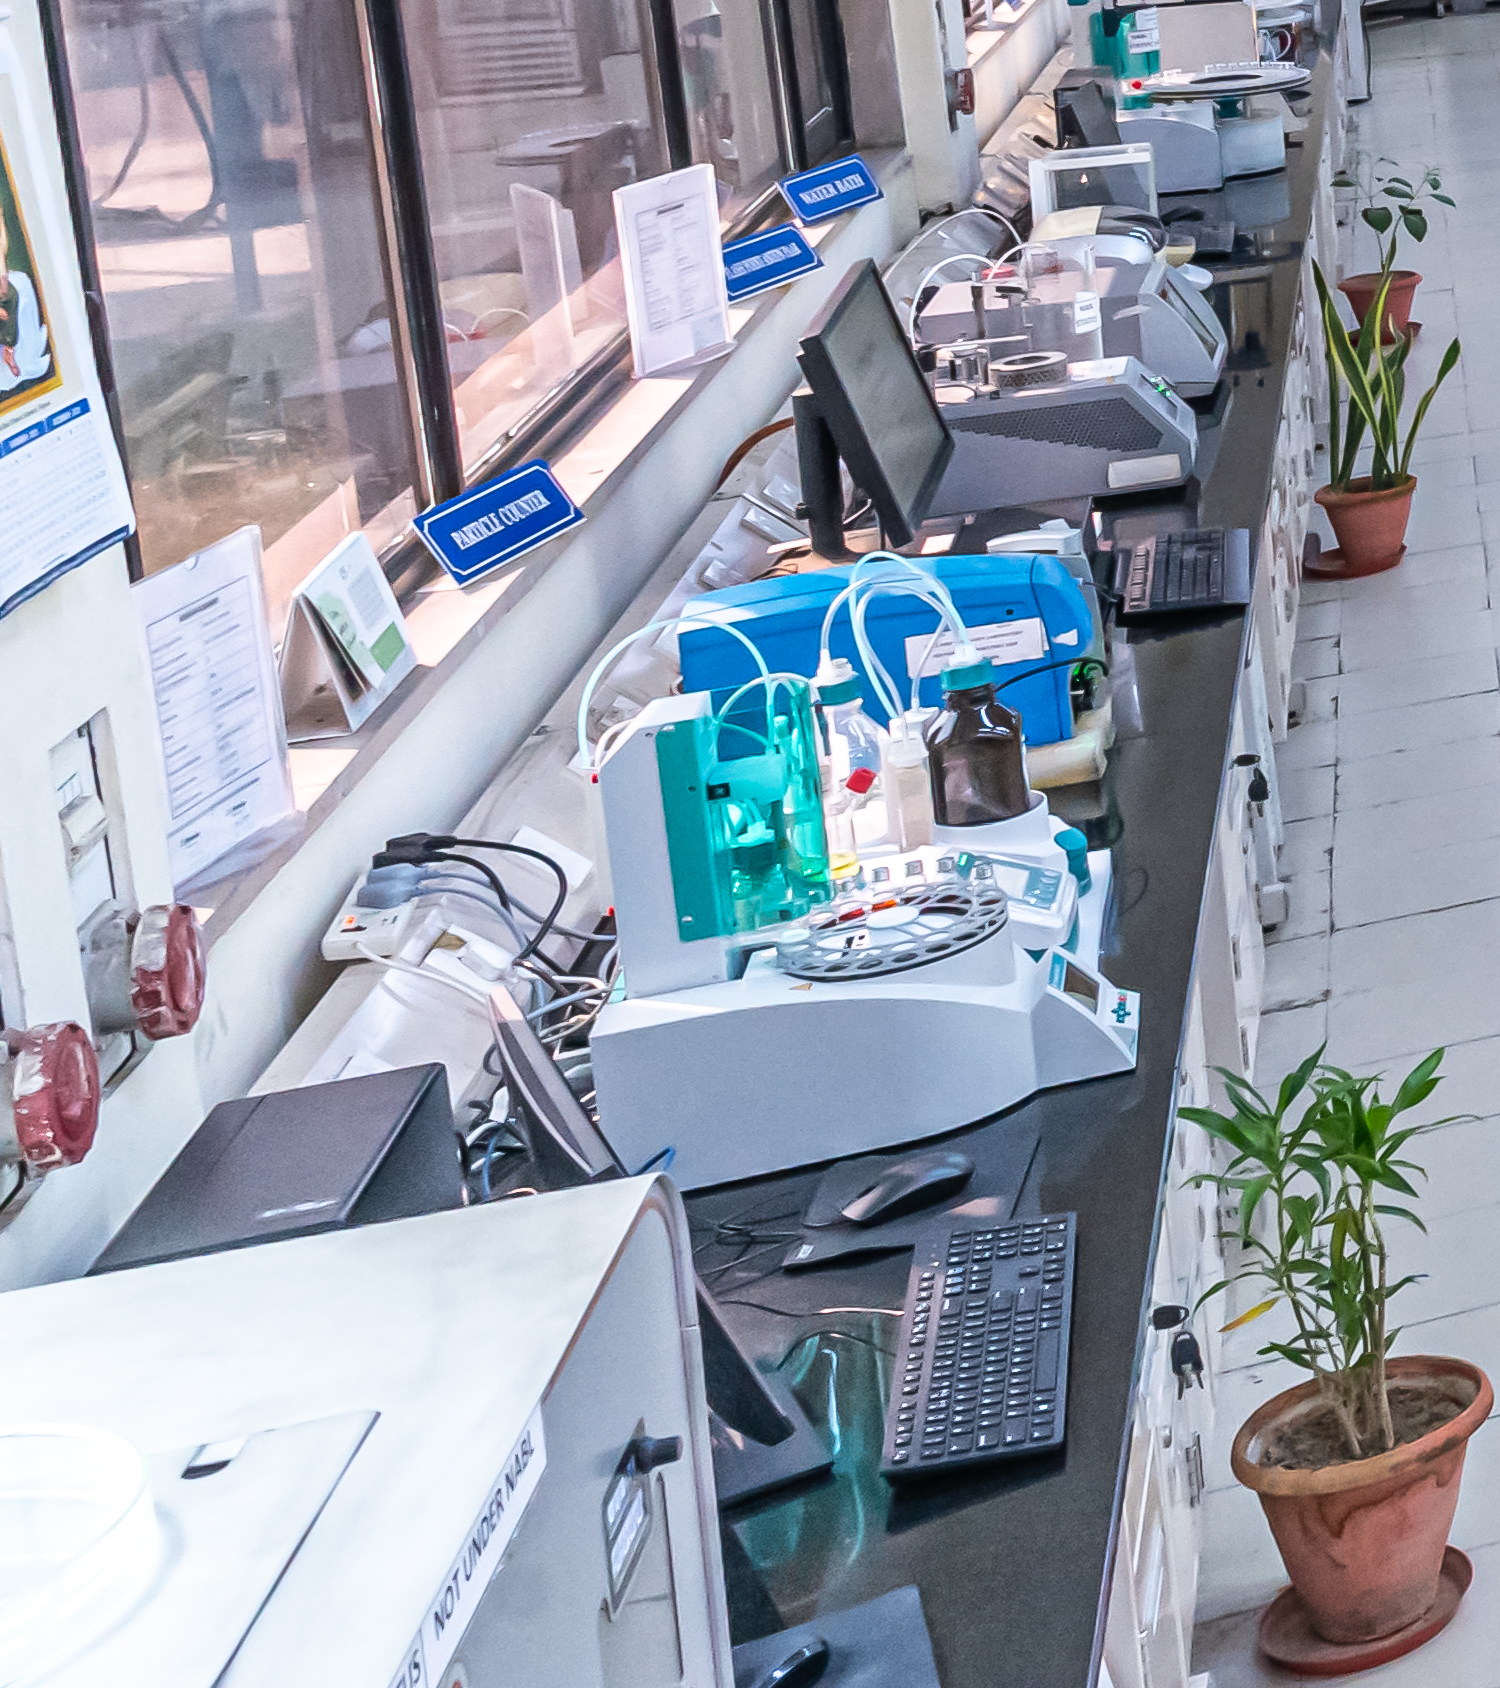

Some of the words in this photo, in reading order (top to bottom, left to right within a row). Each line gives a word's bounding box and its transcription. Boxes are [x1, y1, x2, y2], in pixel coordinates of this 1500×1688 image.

[450, 512, 506, 551] PARTICLE
[497, 488, 552, 526] COUNTER
[433, 1566, 461, 1641] NOT
[463, 1487, 504, 1582] UNDER
[504, 1430, 535, 1502] NABL
